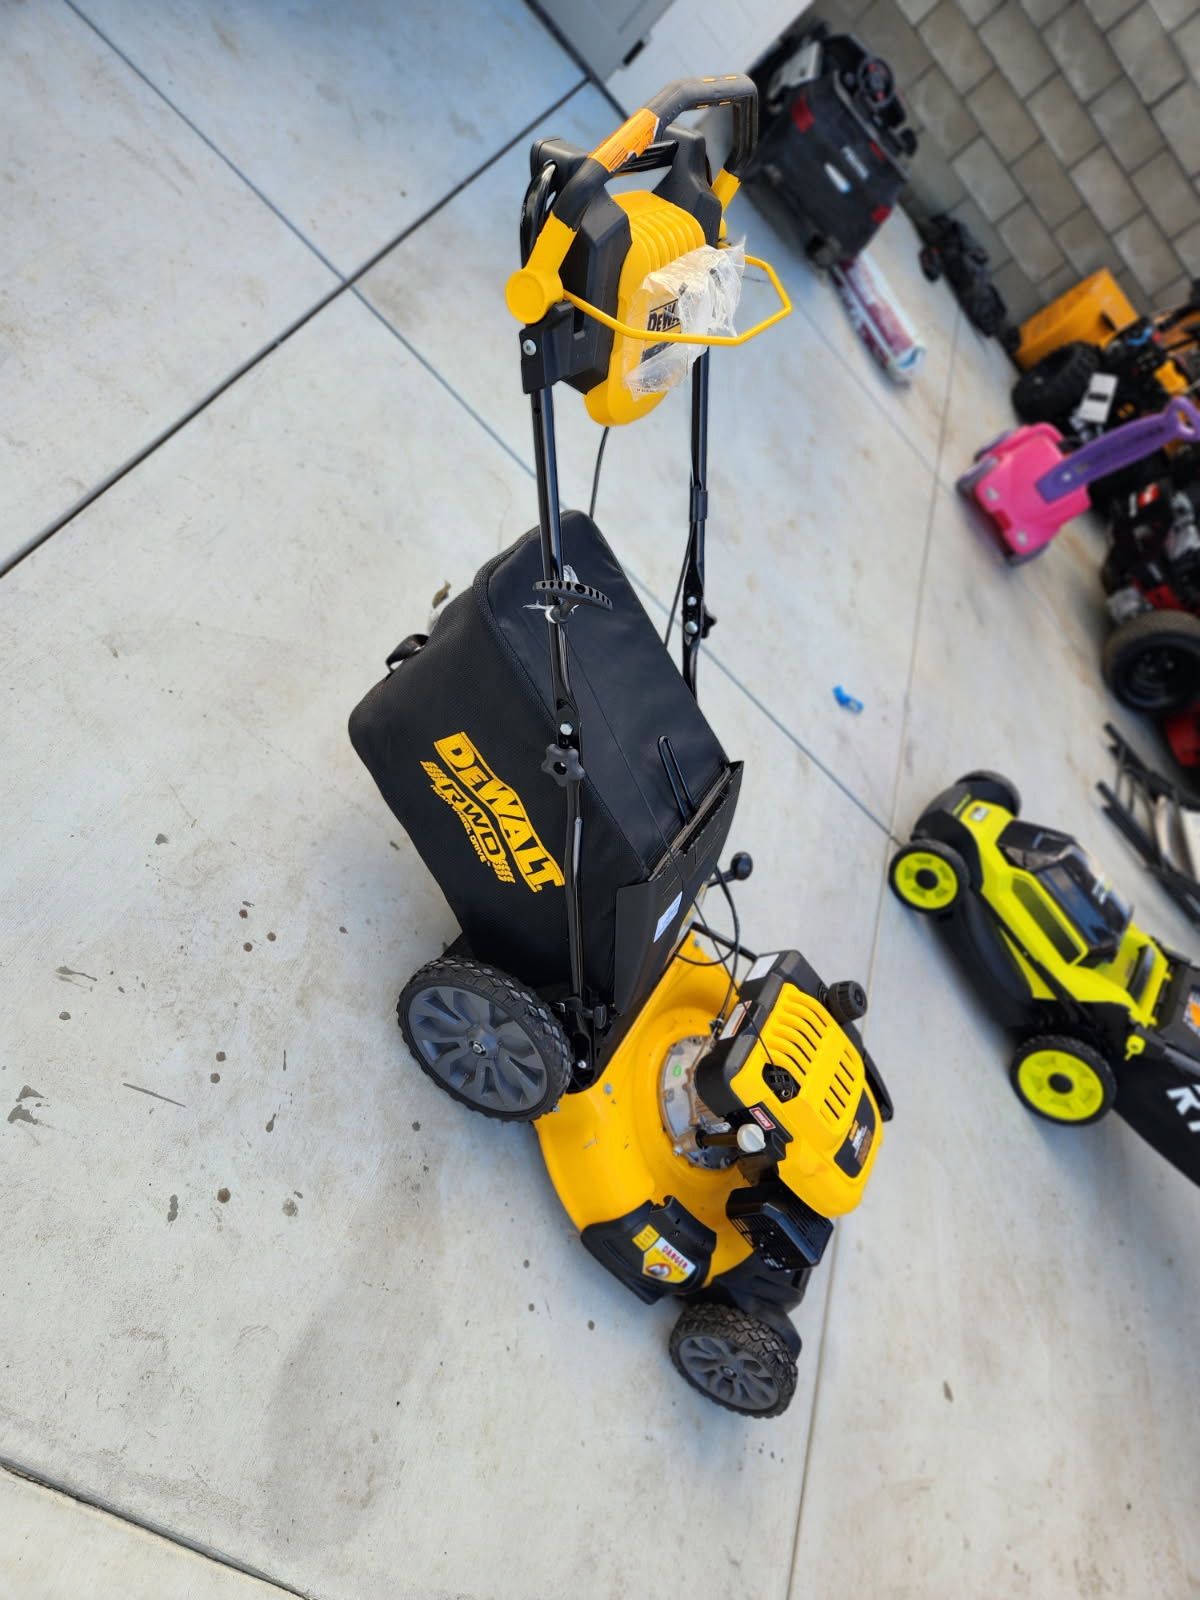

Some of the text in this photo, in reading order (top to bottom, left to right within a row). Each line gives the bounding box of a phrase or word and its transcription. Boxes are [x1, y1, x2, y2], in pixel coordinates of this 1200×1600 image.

[434, 732, 564, 892] DEWALT
[441, 783, 502, 856] RWD
[452, 806, 472, 835] WHEEL
[469, 835, 487, 863] DRIVE
[662, 1244, 688, 1269] DANGER
